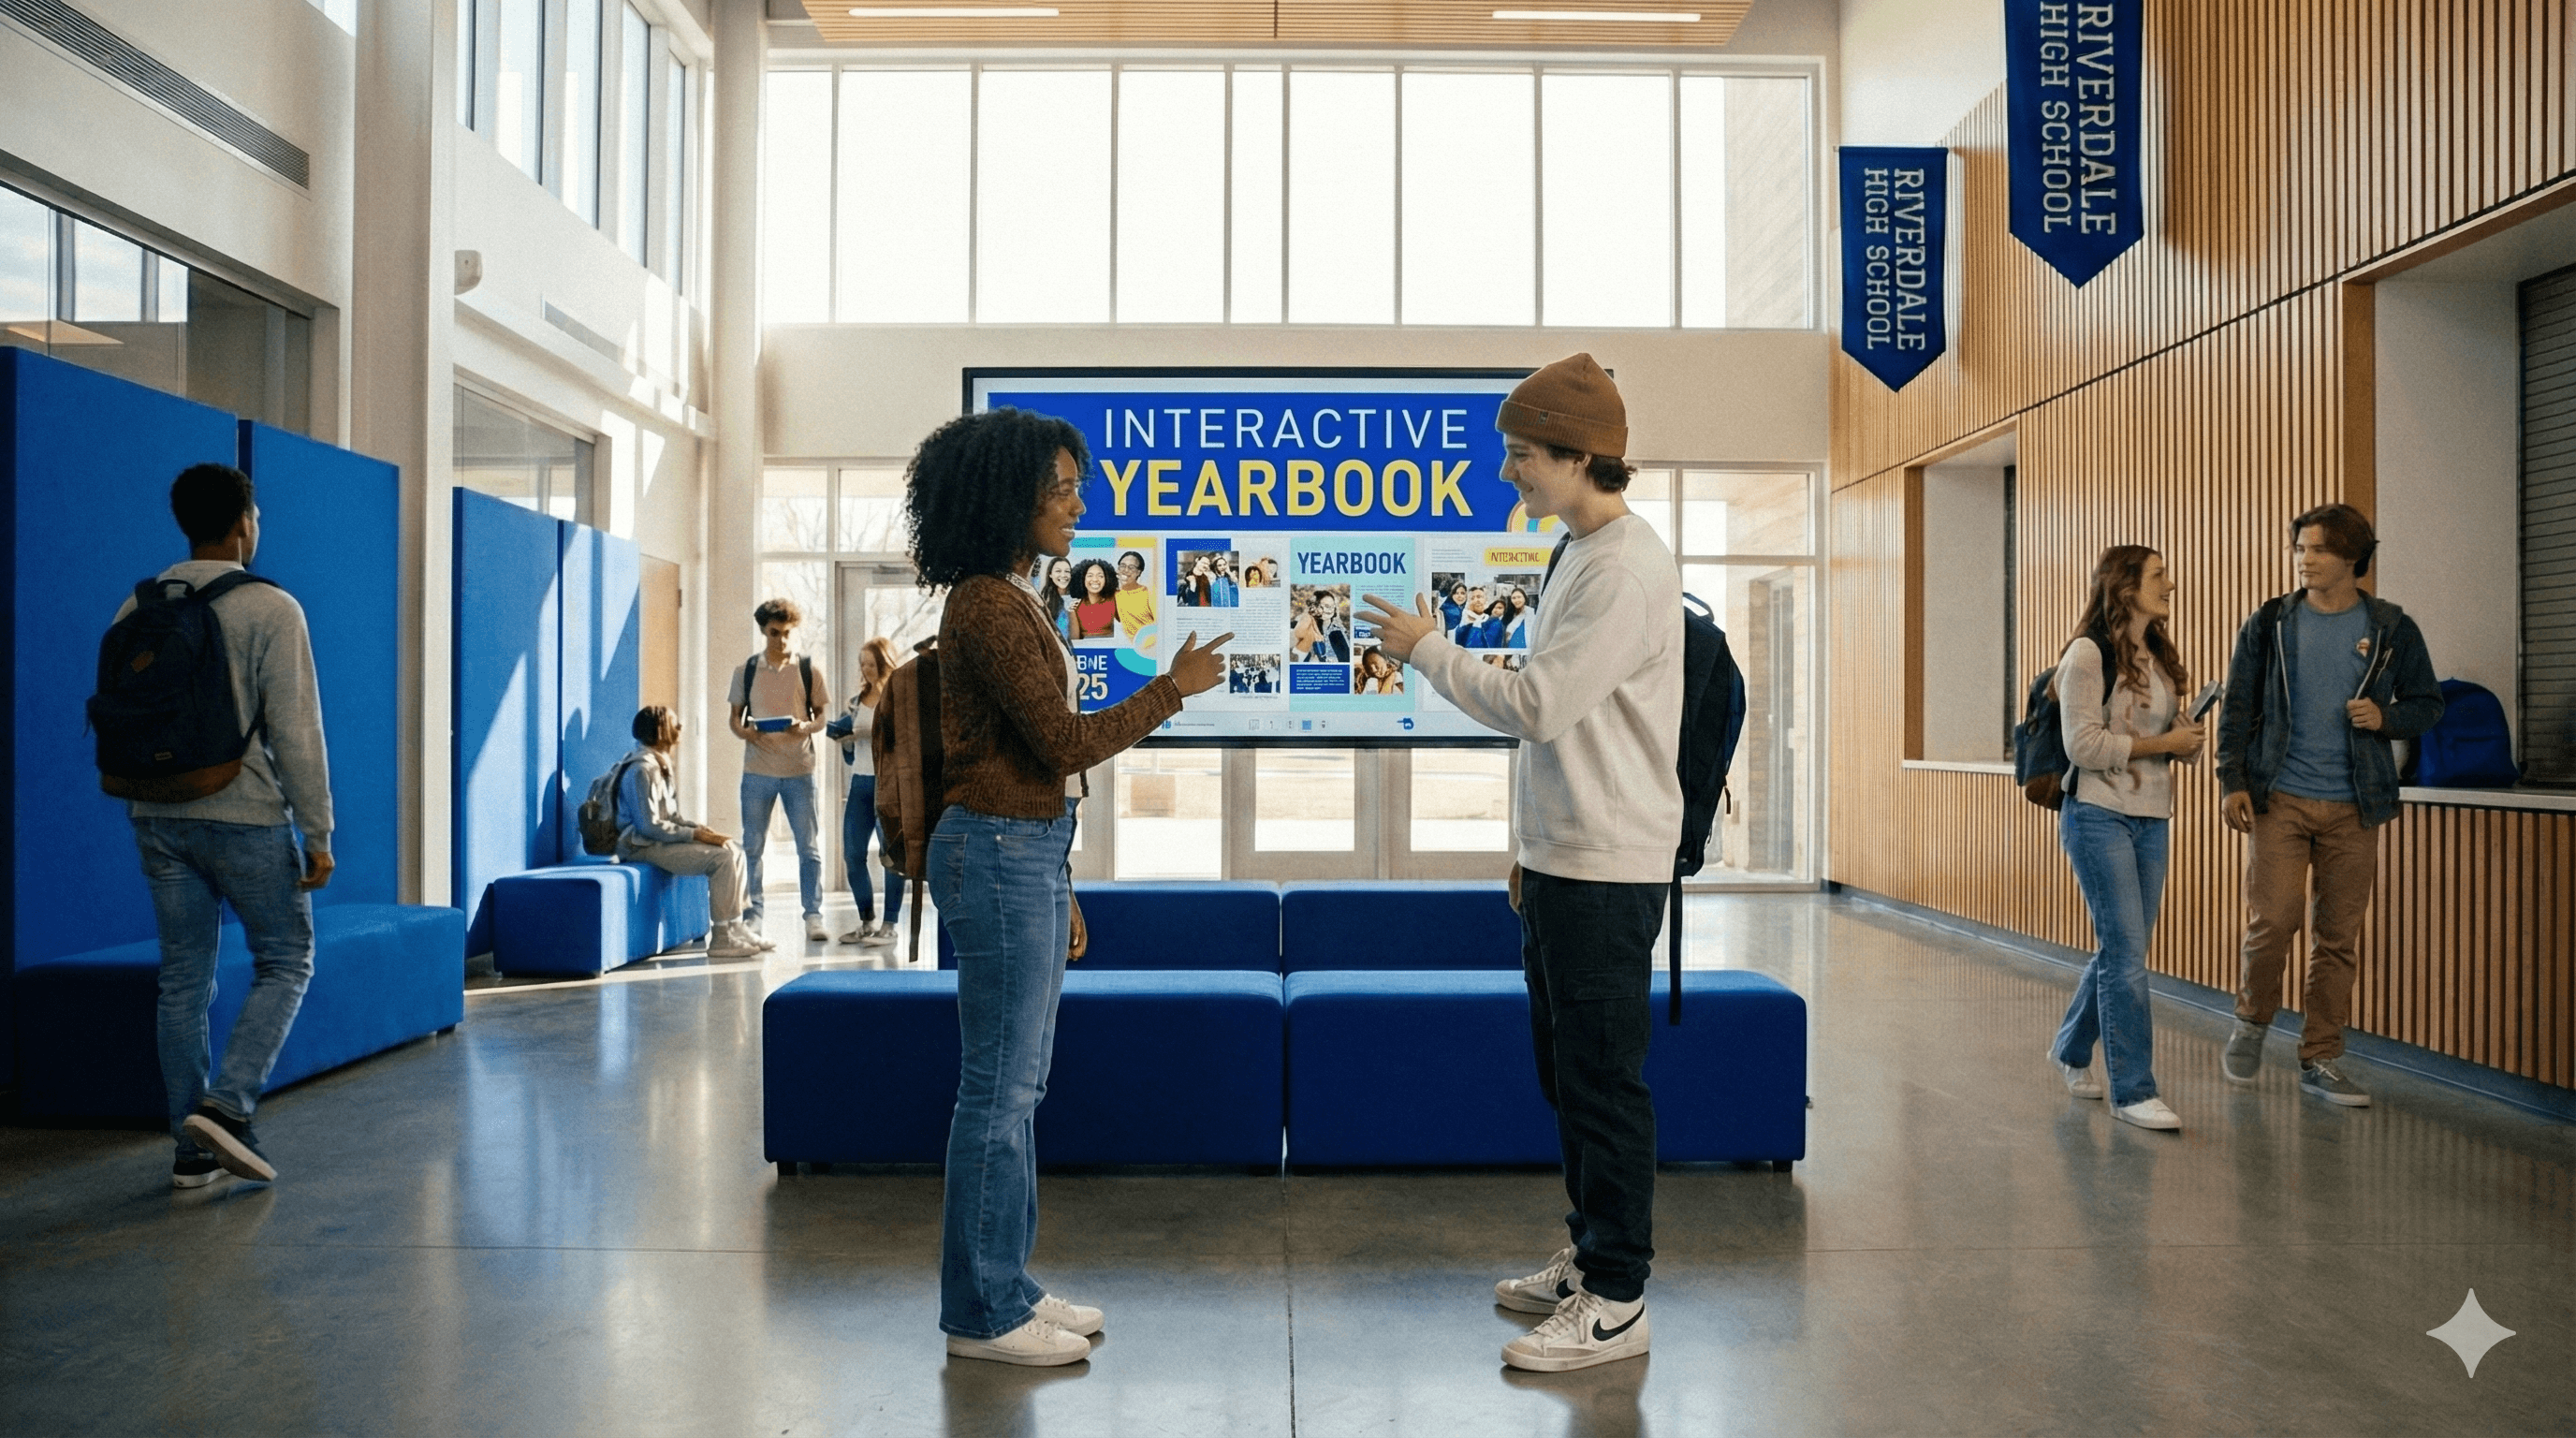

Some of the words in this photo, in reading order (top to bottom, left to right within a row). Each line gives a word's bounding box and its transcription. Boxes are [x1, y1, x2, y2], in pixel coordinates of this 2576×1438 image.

[2040, 1, 2070, 88] HIGH
[2076, 2, 2117, 235] RIVERDALE
[1864, 167, 1889, 234] HIGH
[2041, 100, 2072, 233] SCHOOL
[1866, 245, 1891, 350] SCHOOL
[1894, 168, 1927, 351] RIVERDALE
[1105, 408, 1468, 448] INTERACTIVE
[1099, 459, 1473, 517] YEARBOOK
[1297, 551, 1407, 574] YEARBOOK
